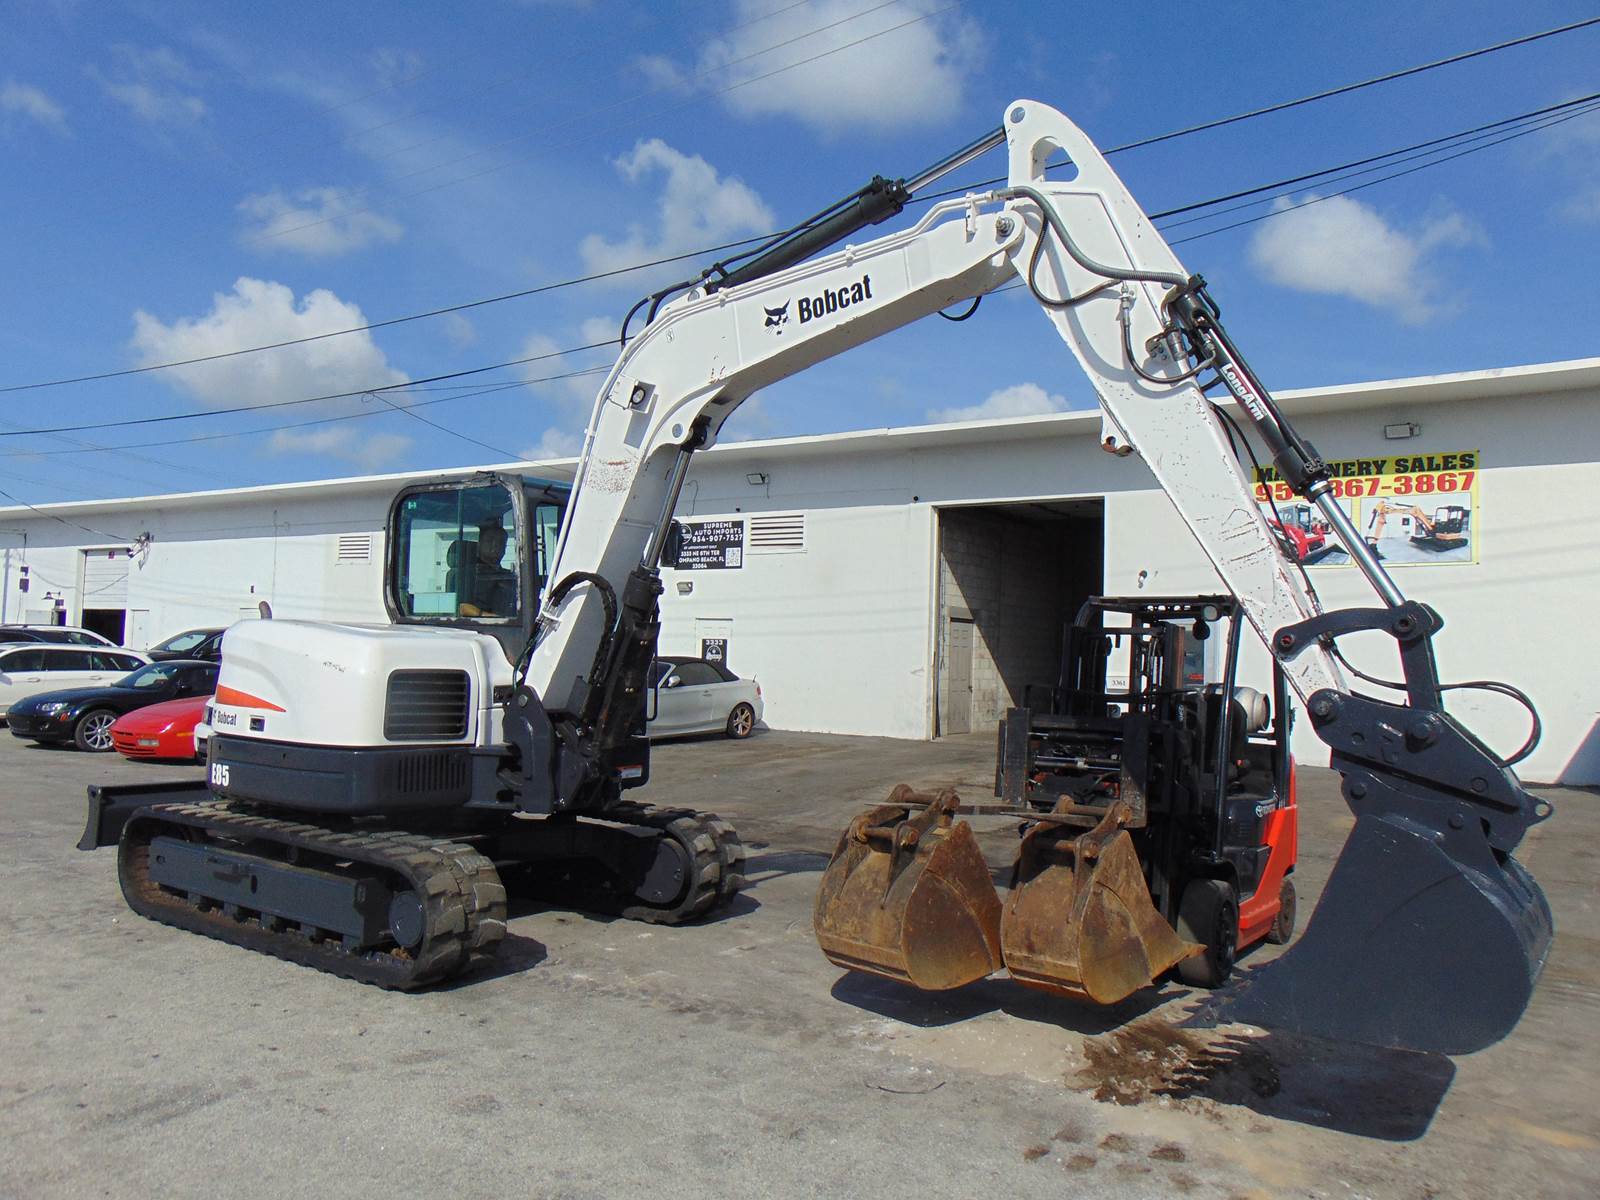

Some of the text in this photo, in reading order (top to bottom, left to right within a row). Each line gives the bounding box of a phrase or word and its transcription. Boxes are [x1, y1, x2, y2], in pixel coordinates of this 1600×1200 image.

[798, 274, 872, 324] Bobcat
[1257, 453, 1475, 482] MNERY SALES
[703, 521, 733, 529] SUPREME
[713, 527, 742, 535] IMPORTS
[217, 710, 237, 726] Bobcat
[211, 762, 230, 787] E85
